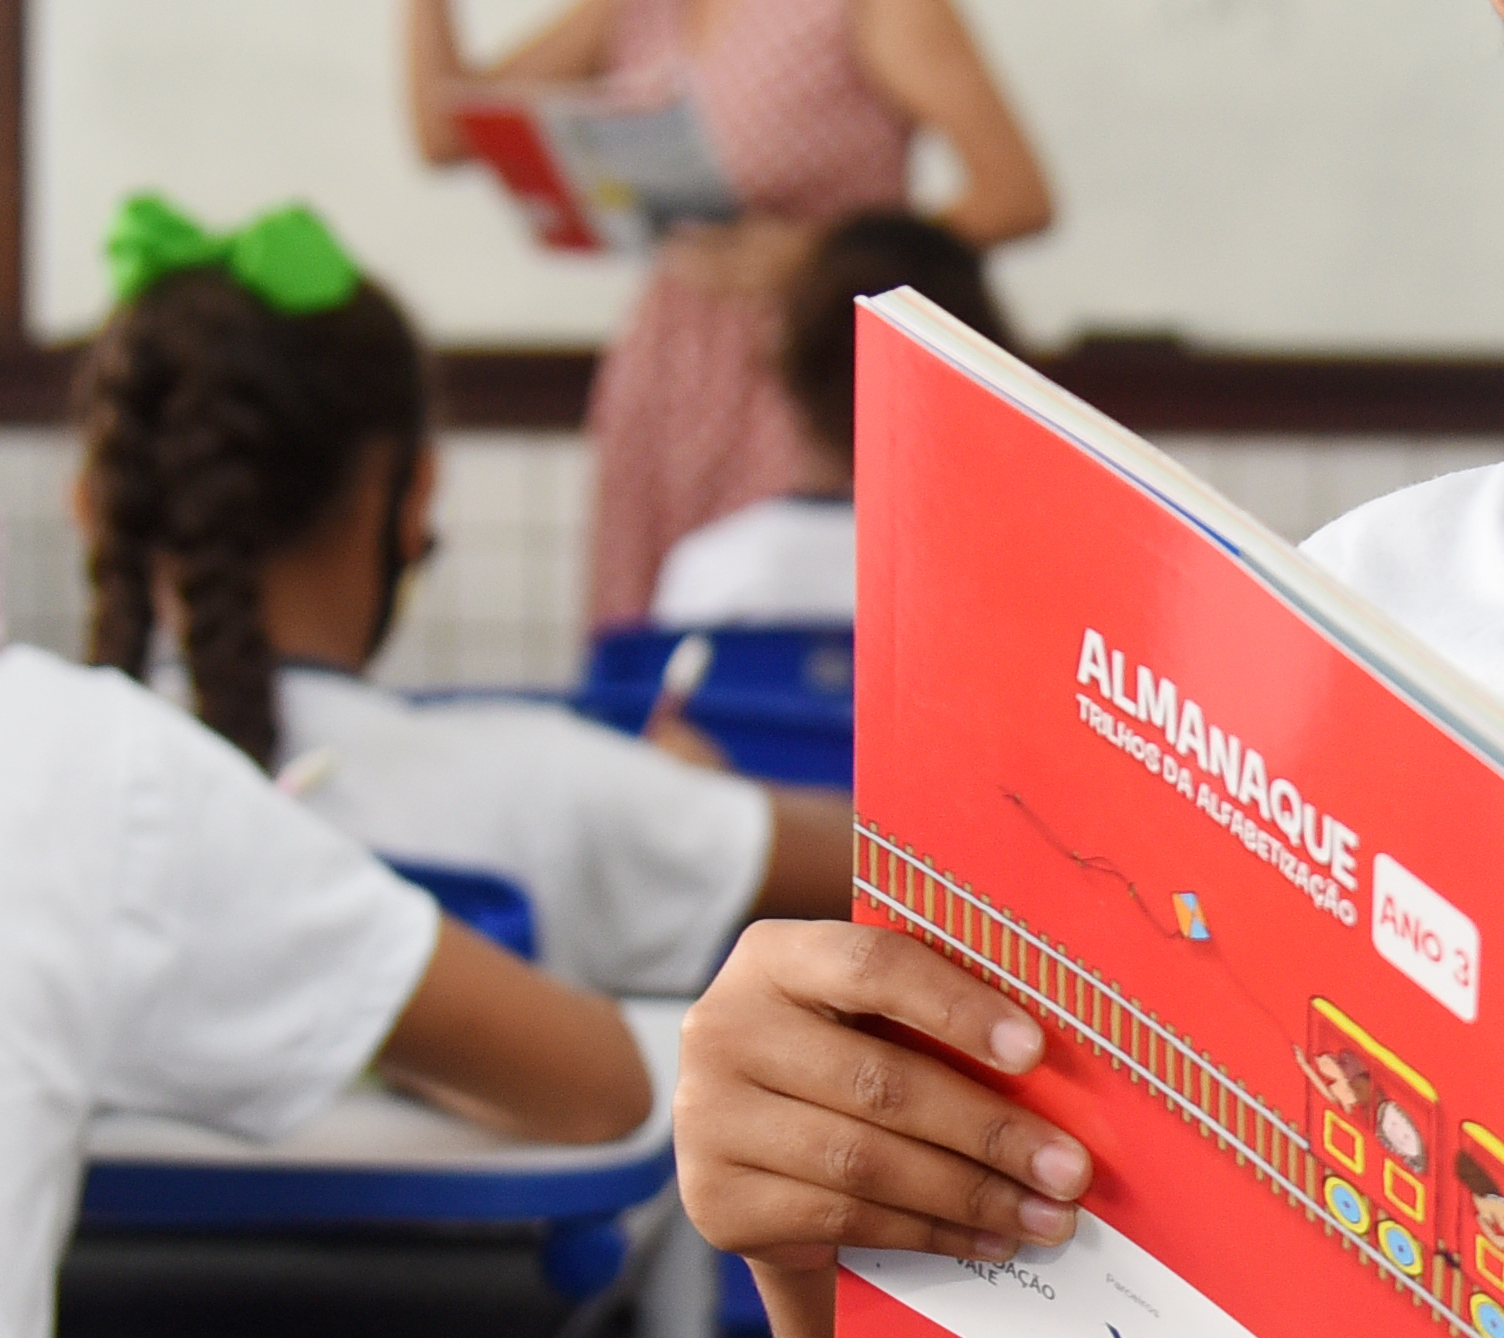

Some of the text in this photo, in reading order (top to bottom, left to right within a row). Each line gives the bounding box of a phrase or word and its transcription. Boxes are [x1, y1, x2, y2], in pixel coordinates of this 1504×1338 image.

[1075, 692, 1358, 926] TRILHOS DA ALFABETIZAÇÃO
[1076, 627, 1360, 893] ALMANAQUE
[1380, 893, 1470, 987] ANO 3
